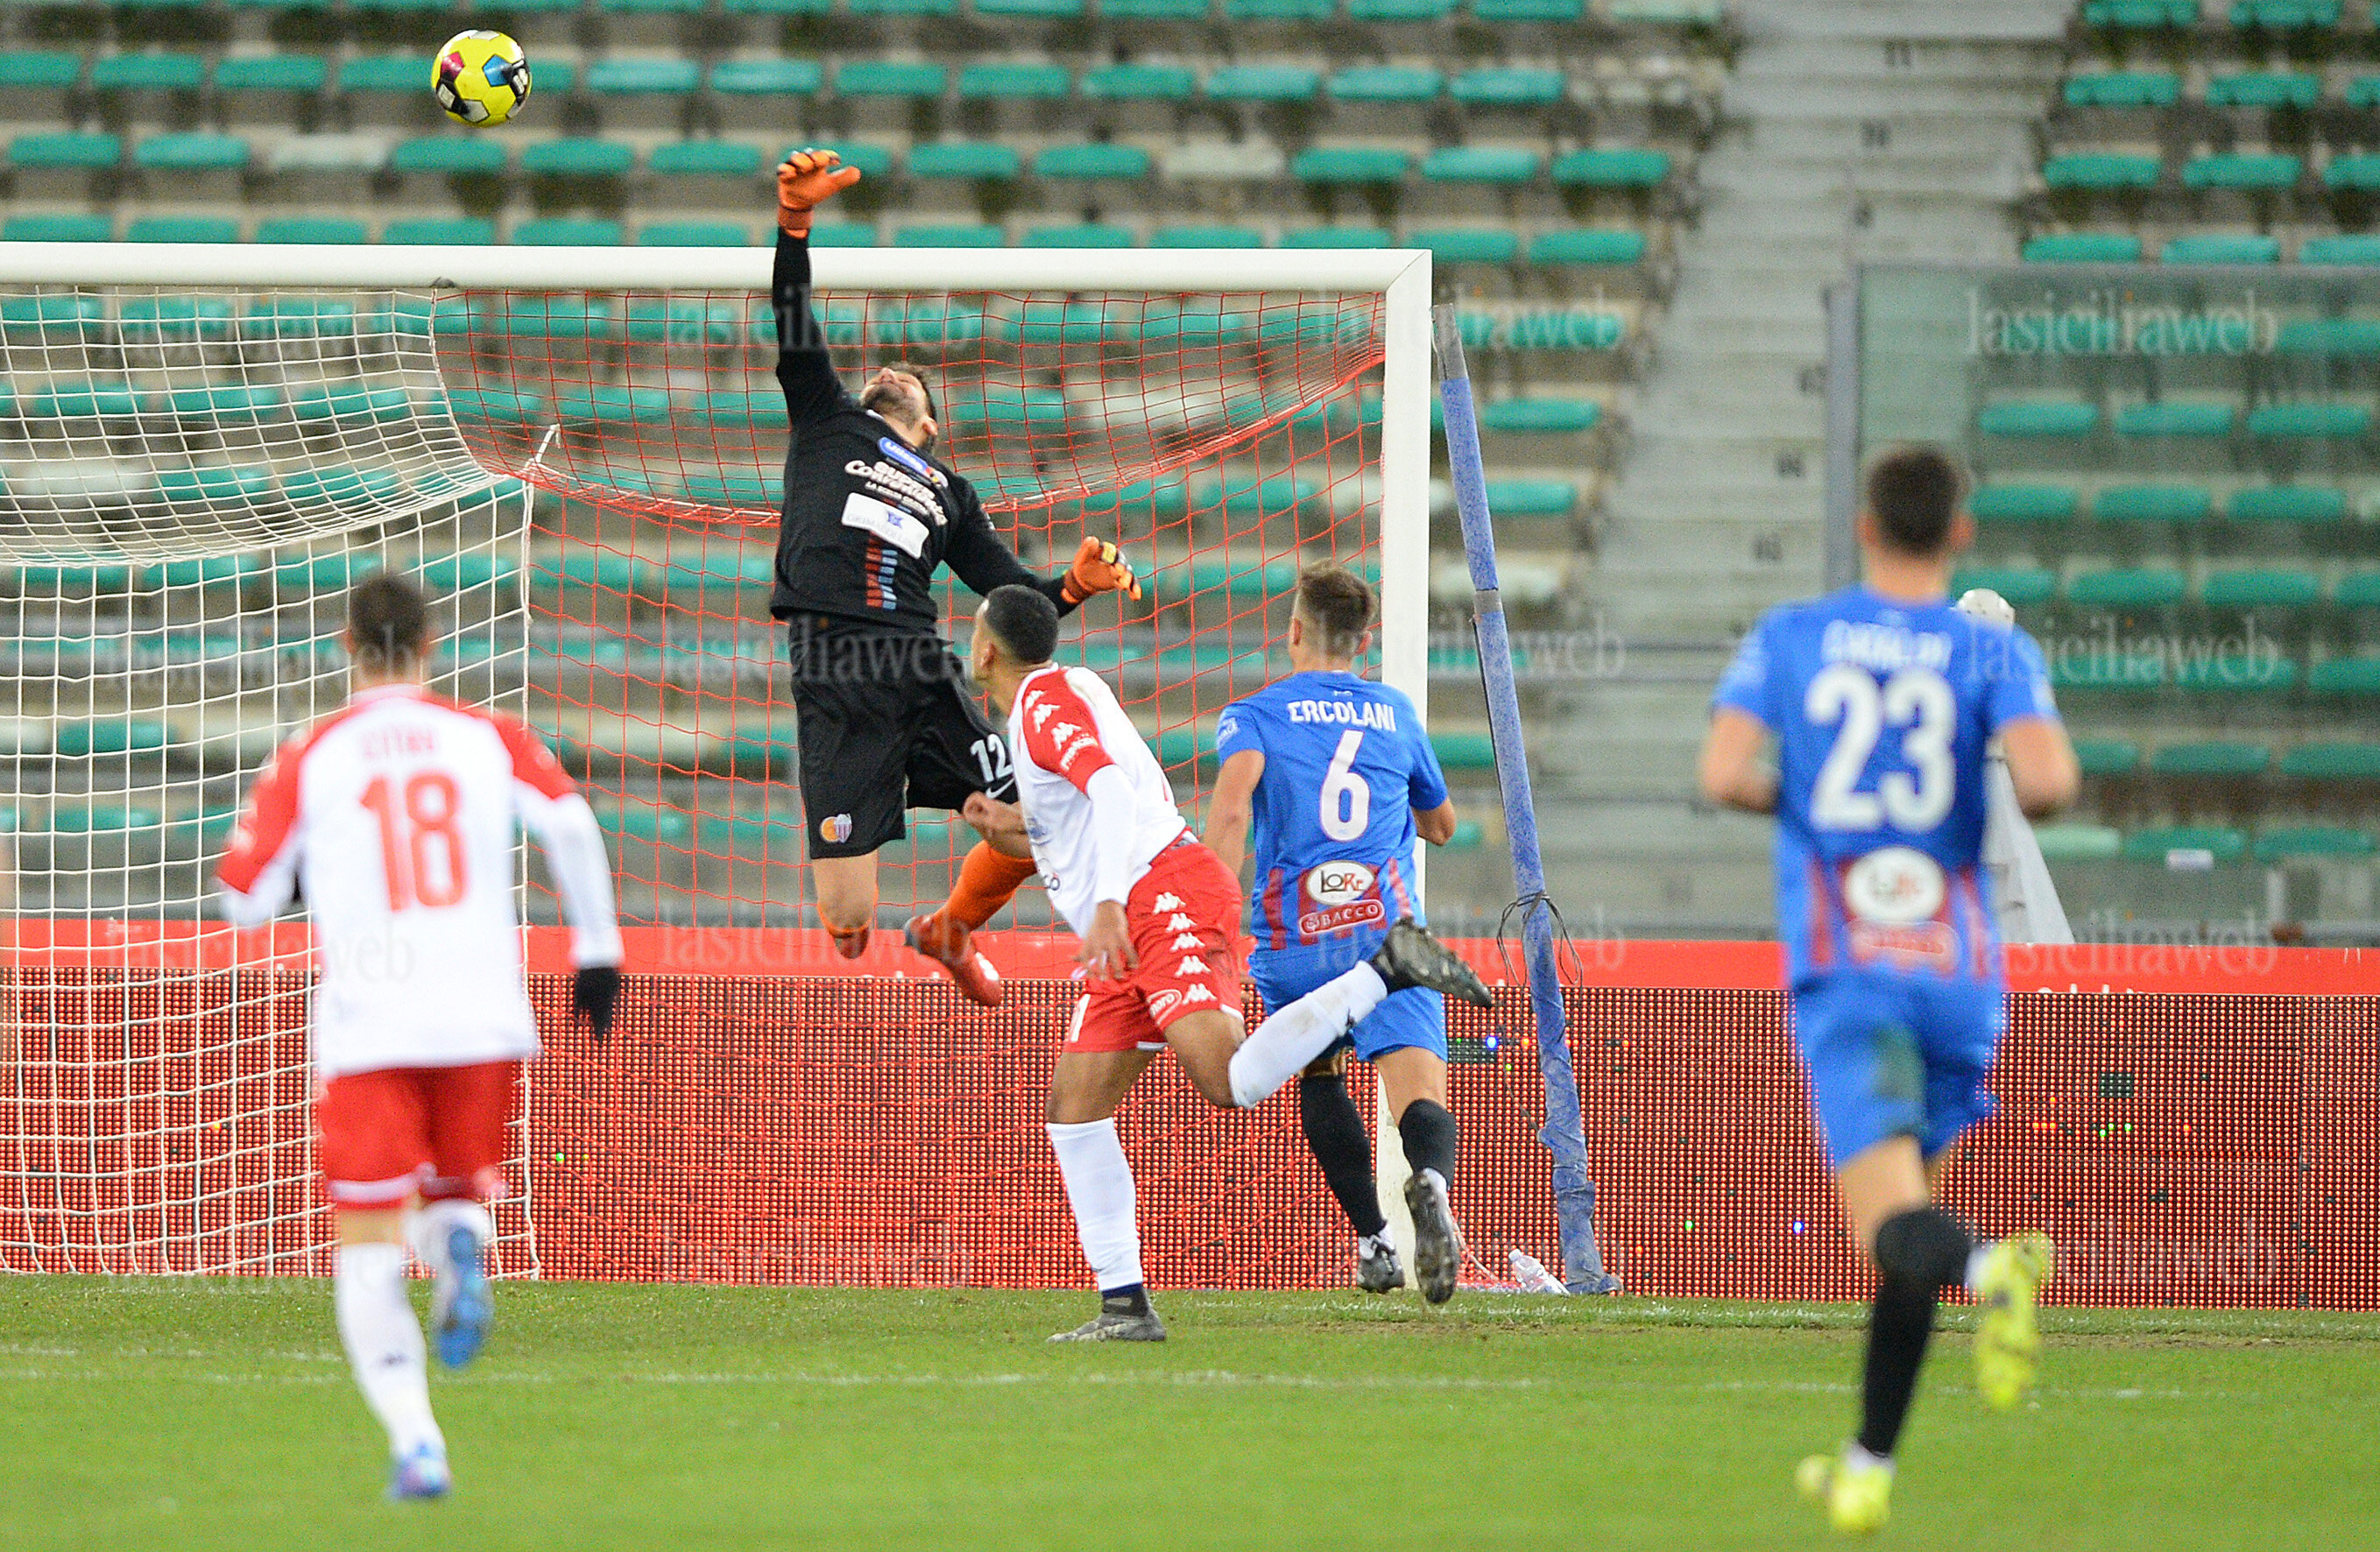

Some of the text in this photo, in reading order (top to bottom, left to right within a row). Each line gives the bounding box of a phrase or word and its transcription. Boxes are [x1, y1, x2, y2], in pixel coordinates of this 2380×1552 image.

[970, 733, 1013, 782] 12
[1287, 700, 1397, 731] ERCOLANI
[1804, 663, 1957, 833] 23
[359, 772, 469, 913] 18
[1320, 729, 1371, 843] 6
